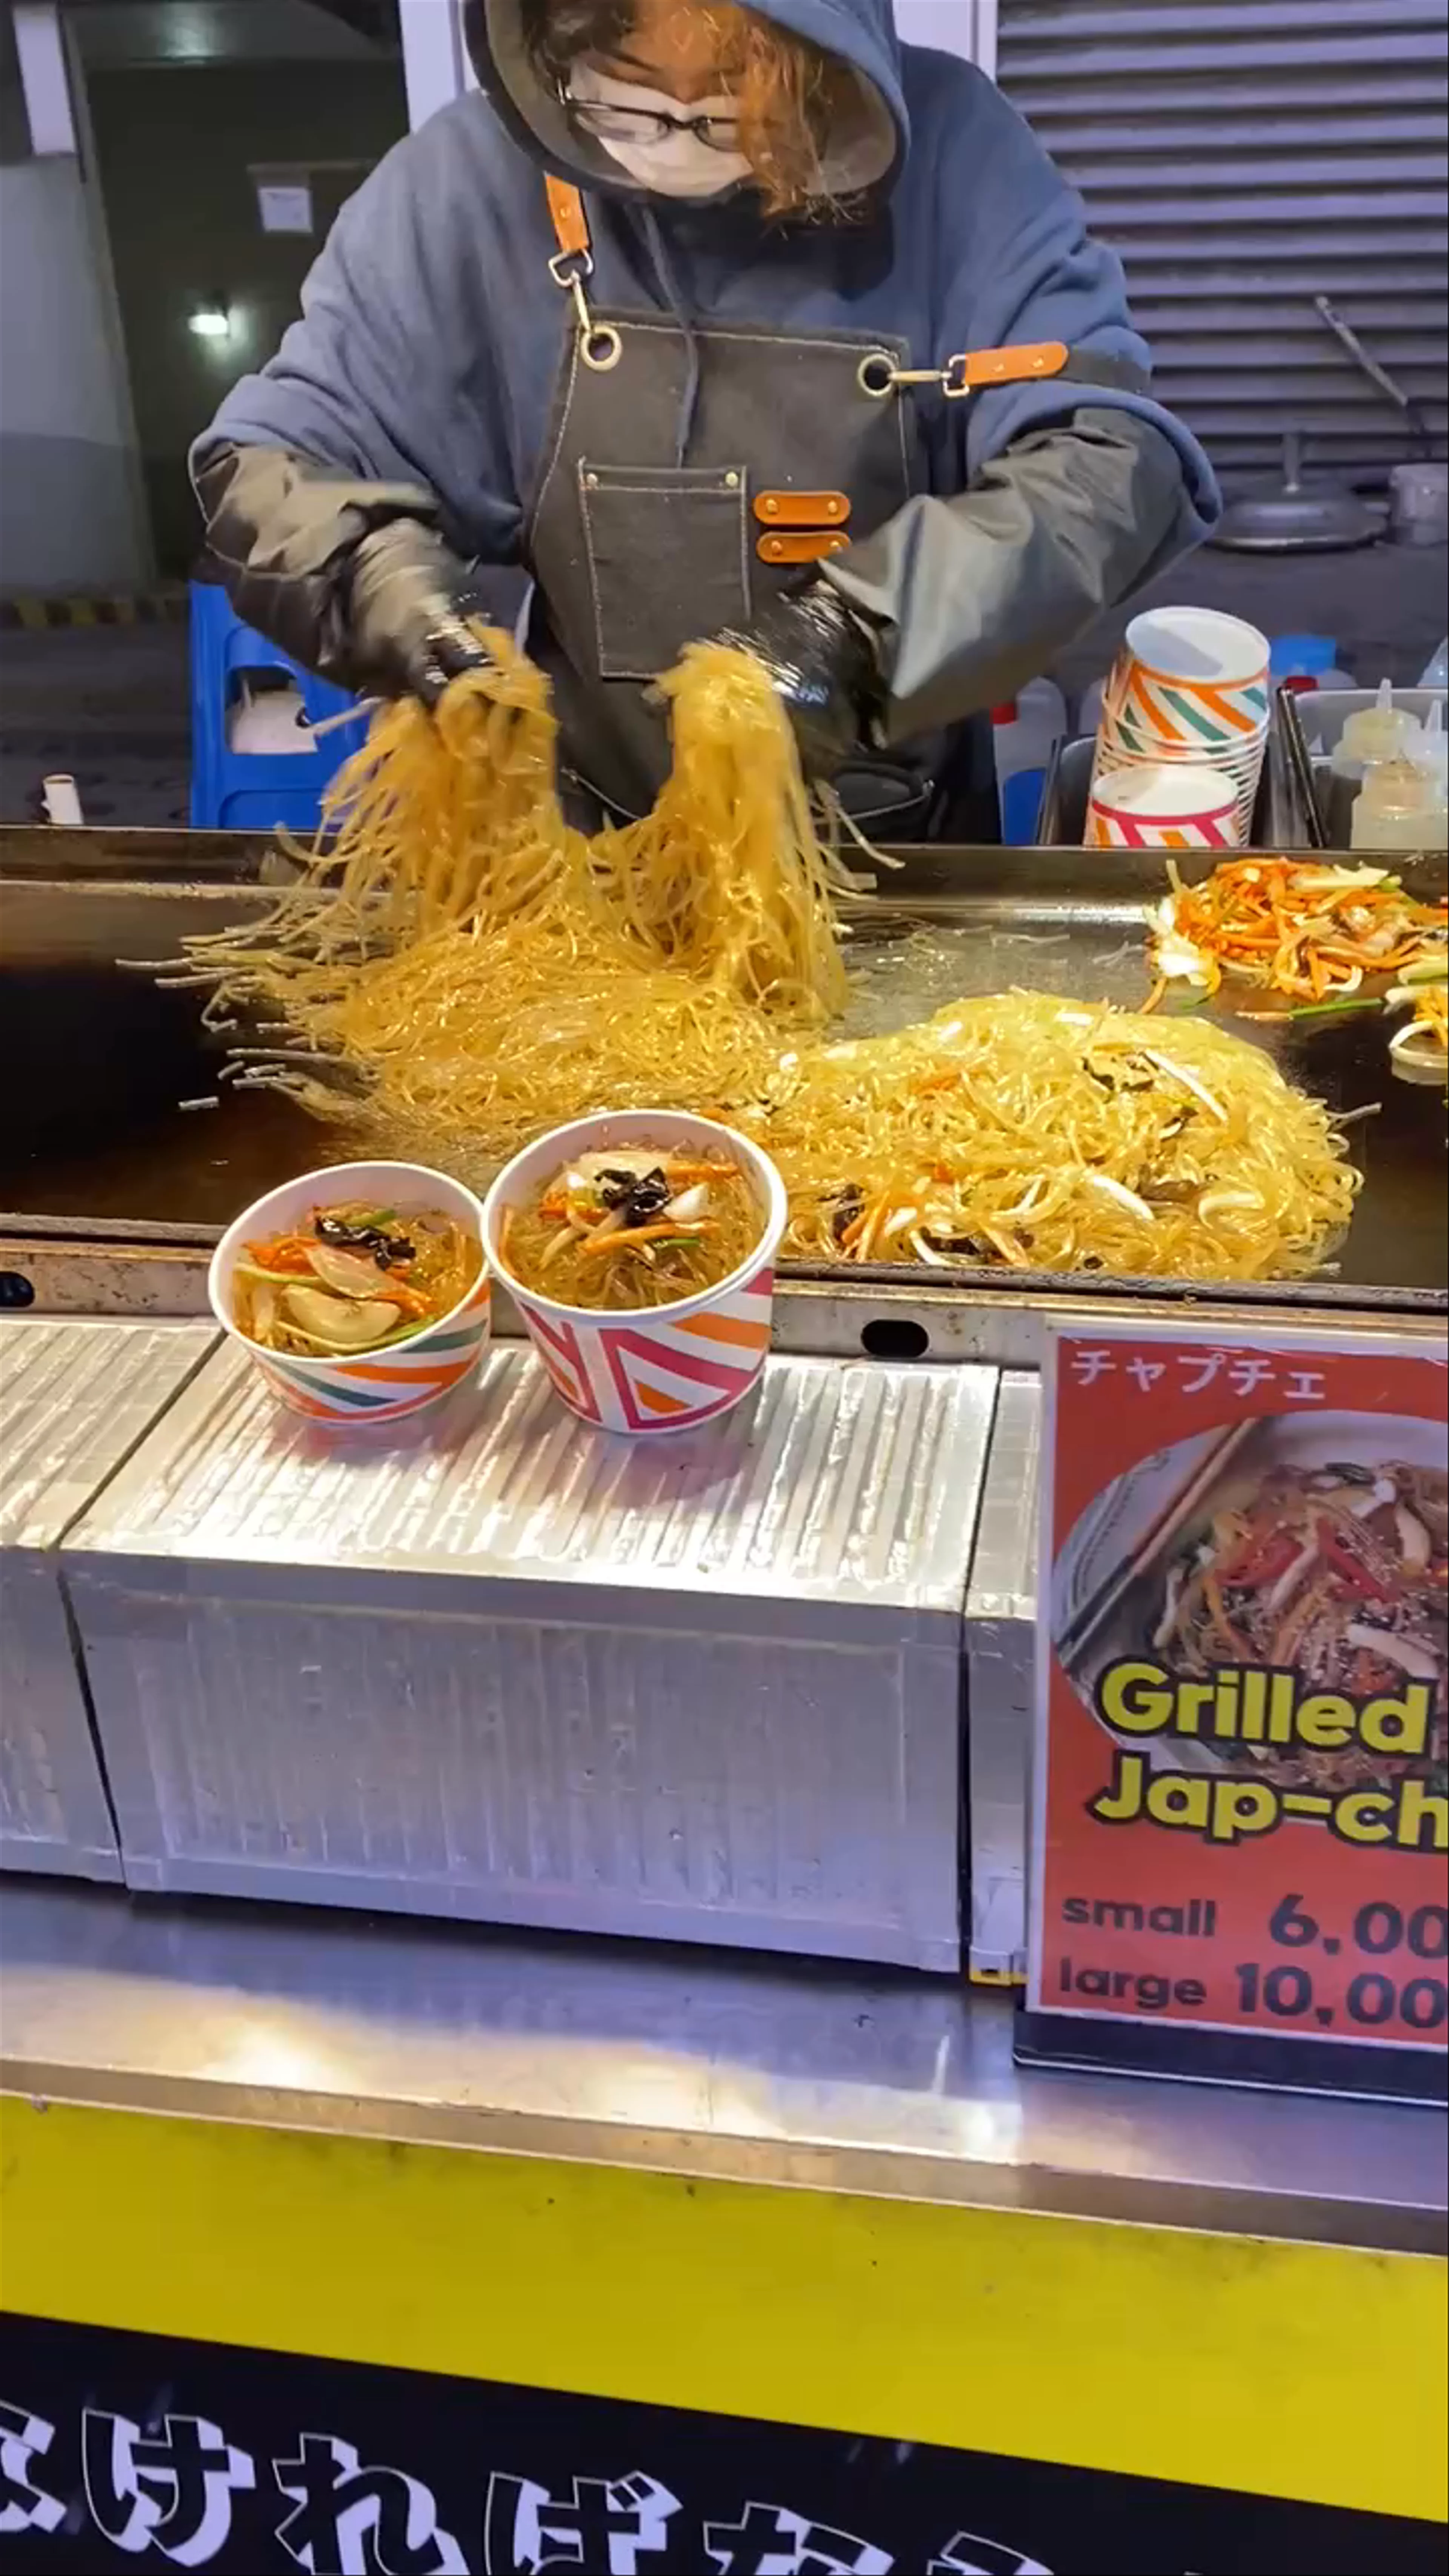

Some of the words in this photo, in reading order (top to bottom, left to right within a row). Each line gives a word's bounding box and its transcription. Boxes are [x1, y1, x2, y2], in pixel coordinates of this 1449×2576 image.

[1071, 1350, 1324, 1399] チャプチェ
[1096, 1659, 1433, 1756] Grilled
[1062, 1896, 1217, 1936] small
[1059, 1957, 1208, 2010] large
